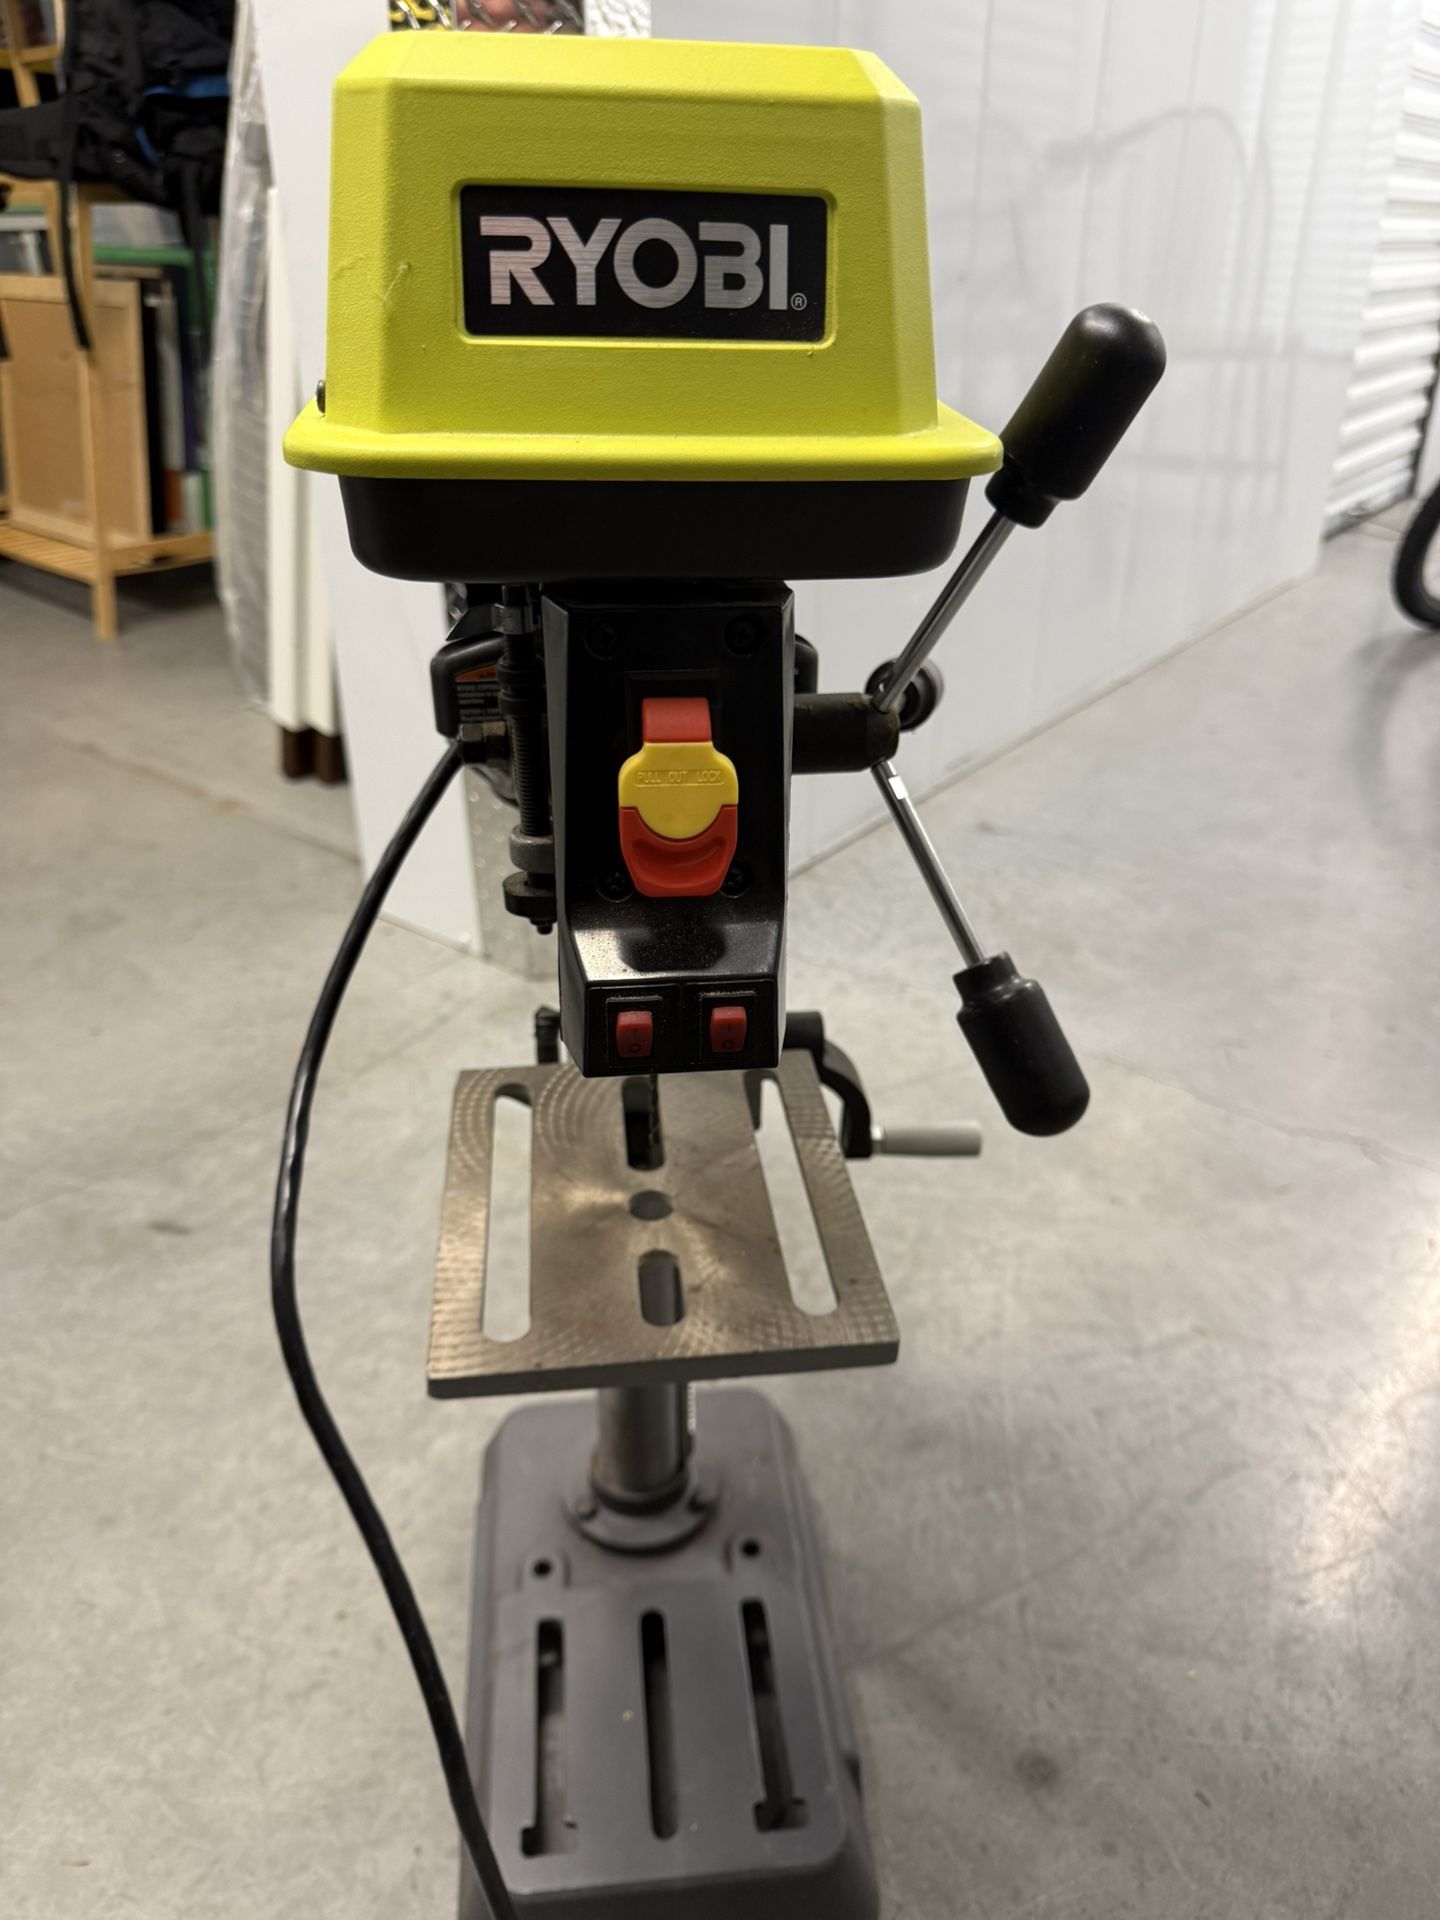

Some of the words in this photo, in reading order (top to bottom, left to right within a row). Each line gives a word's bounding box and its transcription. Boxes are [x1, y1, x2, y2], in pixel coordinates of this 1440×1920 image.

[479, 215, 789, 311] RYOBI
[636, 771, 661, 783] PULL
[668, 770, 688, 783] OUT
[696, 770, 721, 782] LOCK
